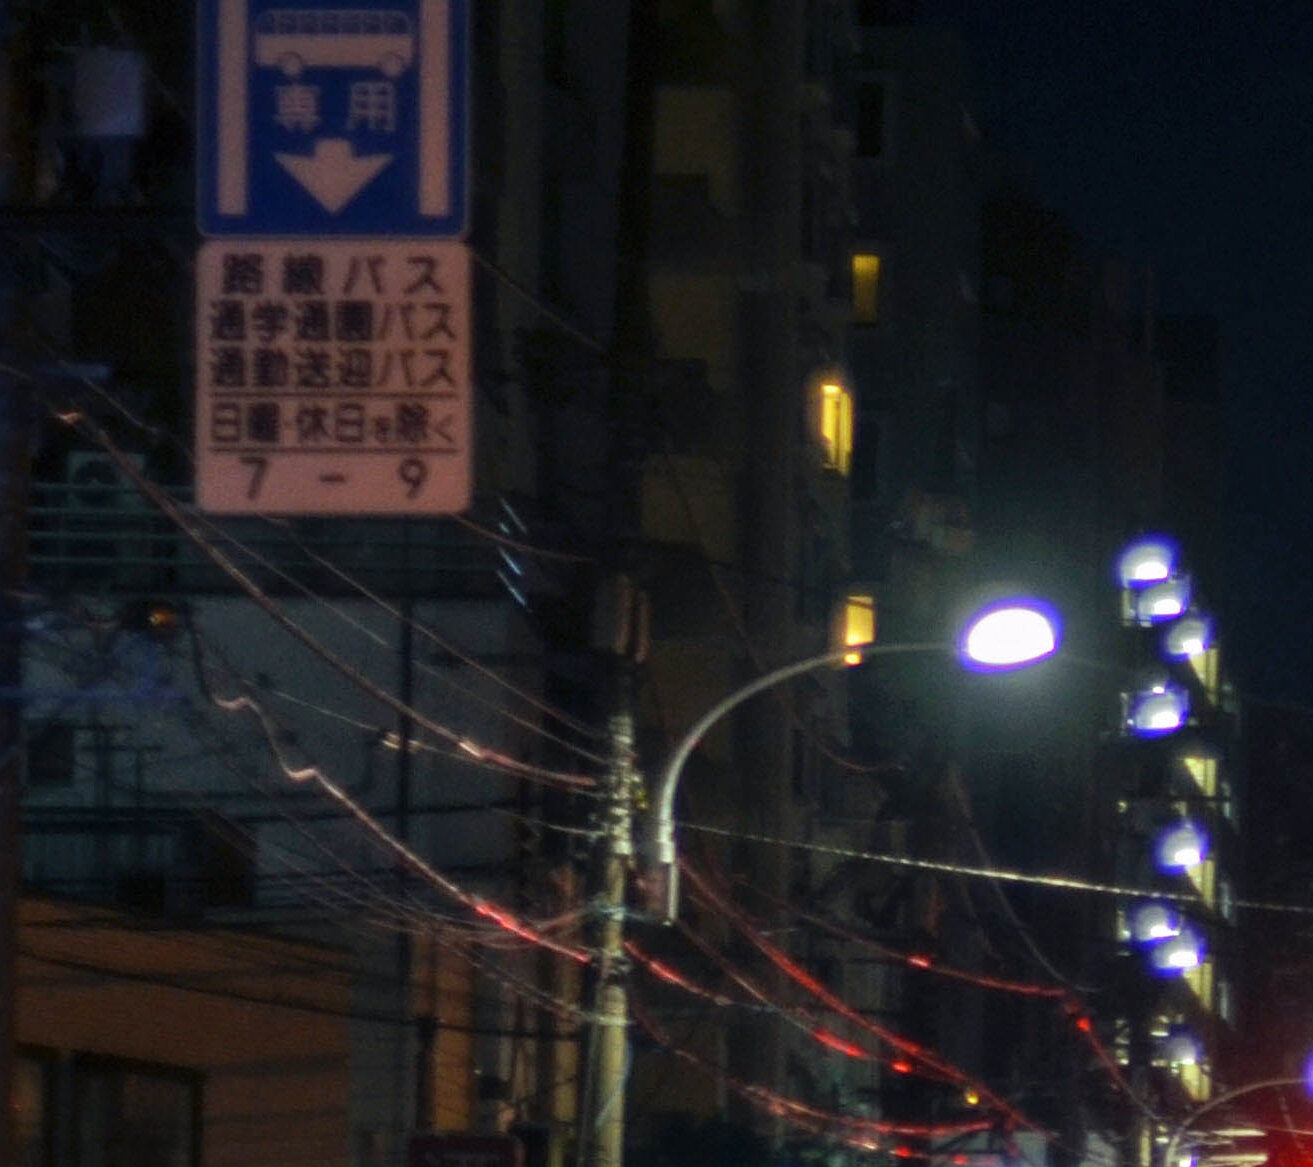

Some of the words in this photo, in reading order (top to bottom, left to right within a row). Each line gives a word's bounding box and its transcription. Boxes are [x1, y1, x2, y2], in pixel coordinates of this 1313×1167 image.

[274, 82, 398, 134] 専用
[221, 253, 443, 295] 路線バス
[209, 300, 456, 343] 通学通園バス
[209, 346, 456, 388] 通勤送迎バス
